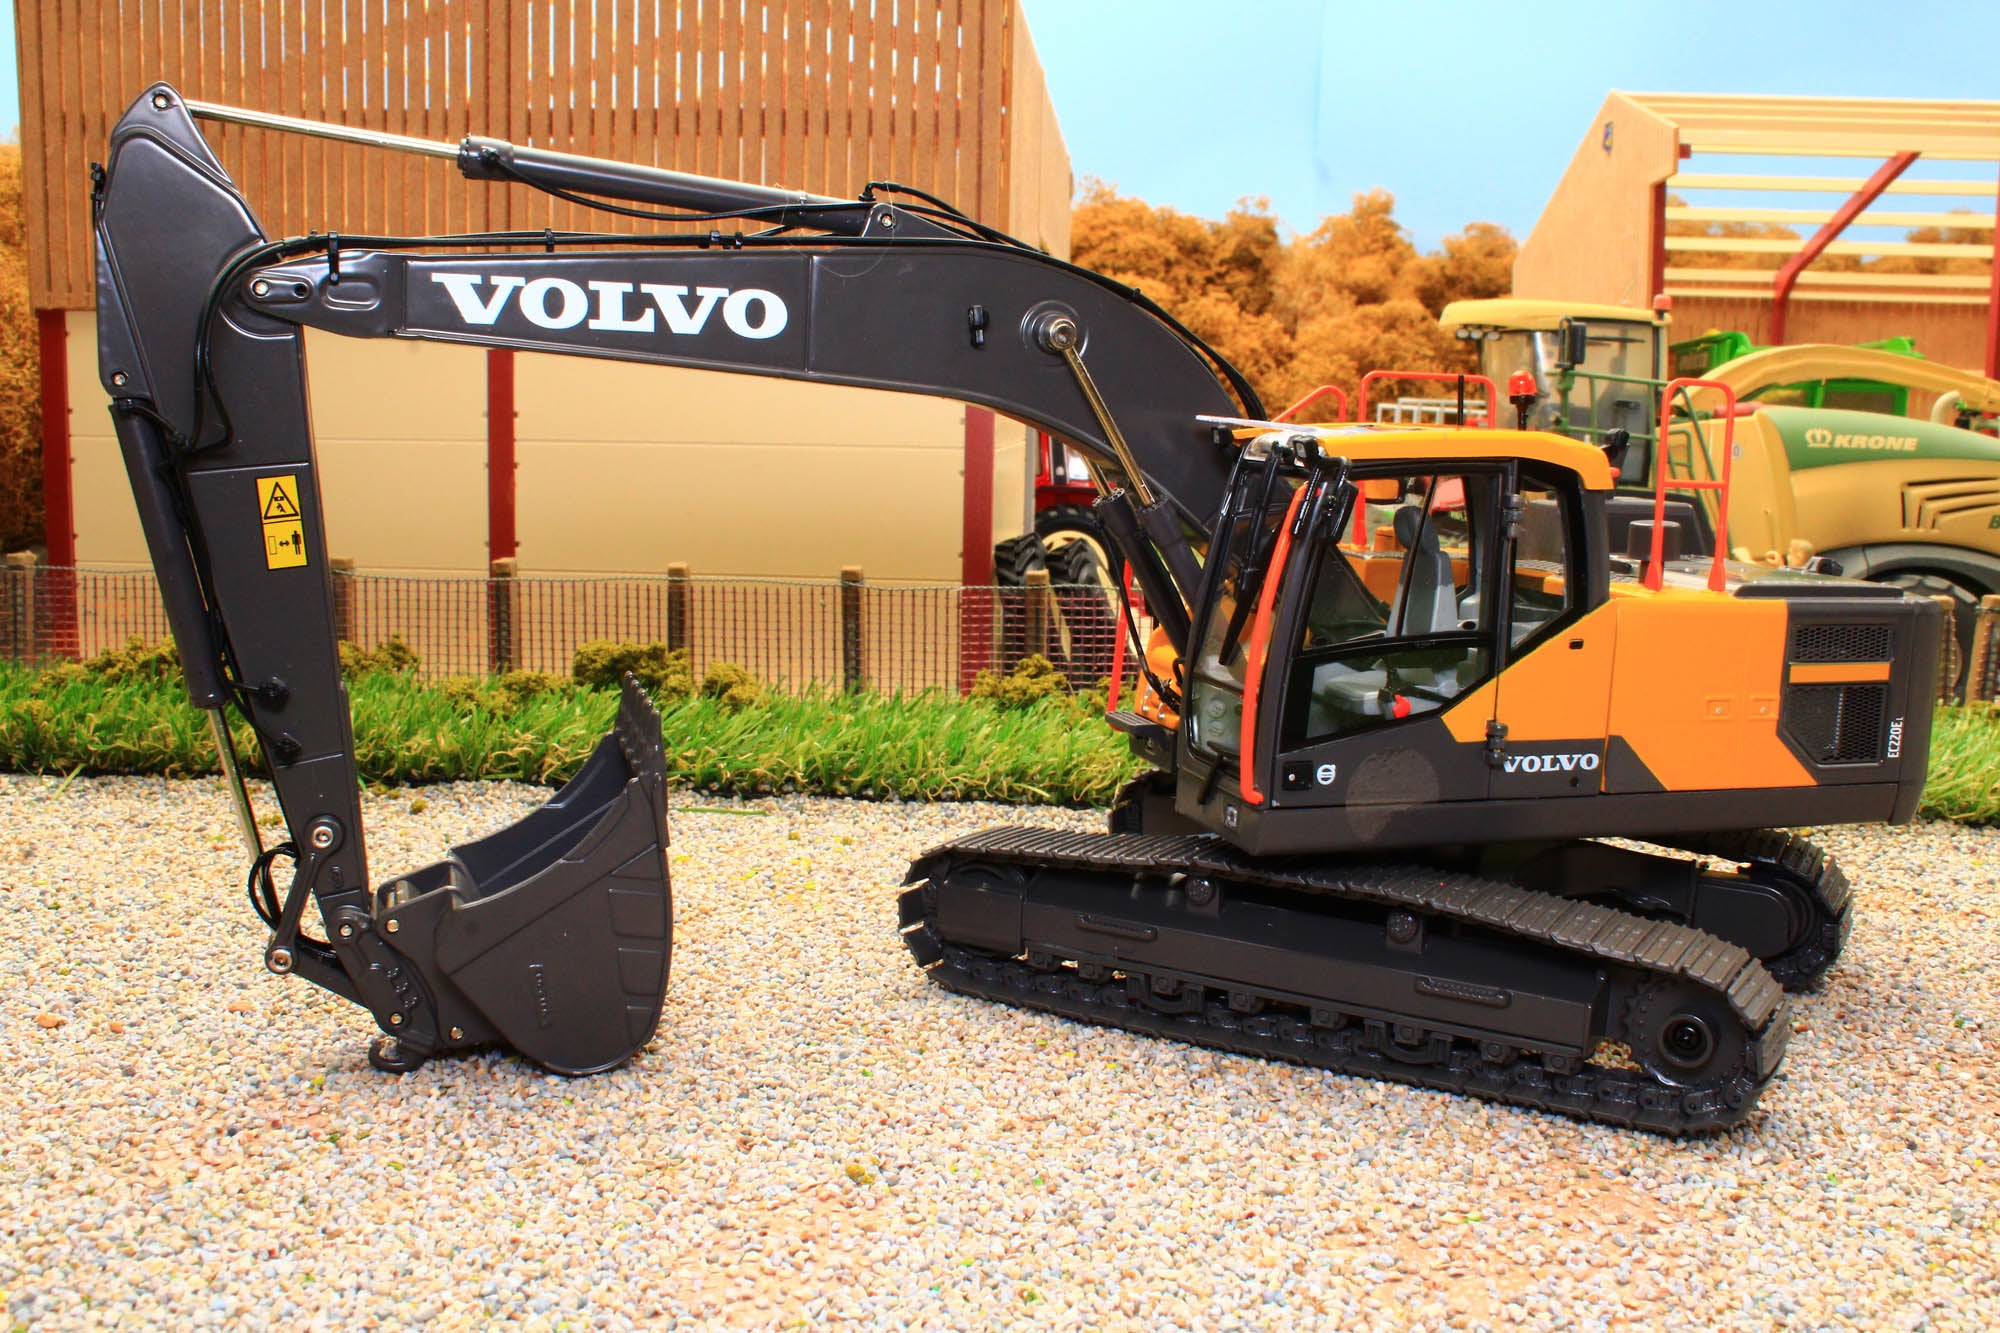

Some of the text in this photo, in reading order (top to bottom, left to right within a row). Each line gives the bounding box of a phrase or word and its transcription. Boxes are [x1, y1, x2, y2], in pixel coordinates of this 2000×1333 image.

[431, 272, 788, 339] VOLVO
[1833, 434, 1919, 451] KRONE
[1503, 753, 1600, 773] VOLVO
